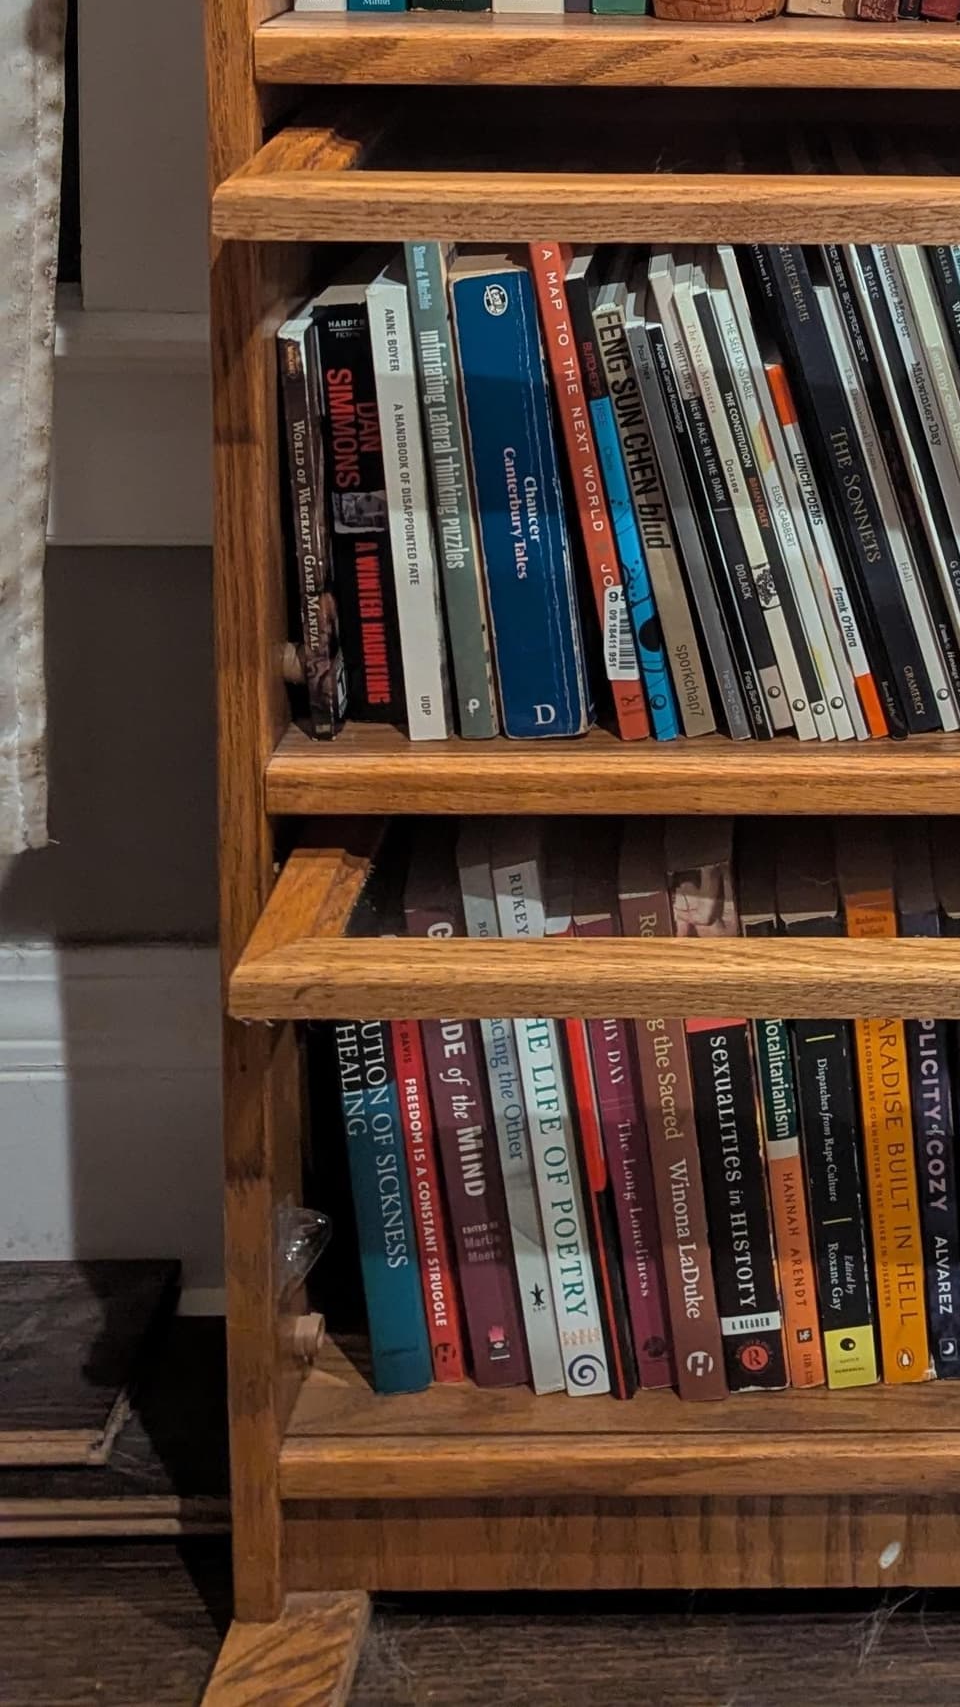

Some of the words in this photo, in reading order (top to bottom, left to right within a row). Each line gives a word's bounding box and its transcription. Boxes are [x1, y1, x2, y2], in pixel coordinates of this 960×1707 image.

[542, 248, 554, 261] A
[383, 307, 396, 336] ANNE
[546, 270, 563, 311] MAP
[387, 337, 400, 373] BOYER
[557, 322, 570, 347] TO
[394, 402, 403, 413] A
[561, 356, 579, 396] THE
[327, 368, 359, 489] SIMMONS
[395, 415, 410, 465] HANDBOOK
[571, 406, 590, 454] NEXT
[399, 467, 411, 482] OF
[502, 447, 525, 534] Canterbury
[582, 465, 604, 533] WORLD
[793, 452, 813, 487] LUNCH
[804, 488, 824, 527] POEMS
[401, 483, 418, 559] DISAPPOINTED
[522, 475, 541, 543] Chaucer
[407, 561, 421, 587] FATE
[513, 536, 528, 580] Tales
[832, 586, 849, 613] Frank
[841, 615, 858, 649] O'Hara
[419, 695, 432, 716] UDP
[335, 1024, 368, 1137] HEALING
[404, 1078, 423, 1144] FREEDOM
[530, 1062, 562, 1135] LIFE
[371, 1113, 394, 1145] OF
[413, 1148, 425, 1165] IS
[415, 1166, 427, 1179] A
[542, 1145, 570, 1187] OF
[728, 1187, 741, 1208] in
[887, 1140, 911, 1213] BUILT
[375, 1153, 409, 1270] SICKNESS
[418, 1181, 438, 1254] CONSTANT
[668, 1158, 692, 1239] Winona
[781, 1172, 798, 1238] HANNAH
[551, 1199, 589, 1318] POETRY
[729, 1212, 757, 1310] HISTORY
[894, 1221, 914, 1251] IN
[427, 1257, 448, 1327] STRUGGLE
[677, 1240, 704, 1320] LaDuke
[789, 1246, 807, 1308] ARENDT
[896, 1259, 920, 1327] HELL
[932, 1235, 954, 1315] ALVAREZ
